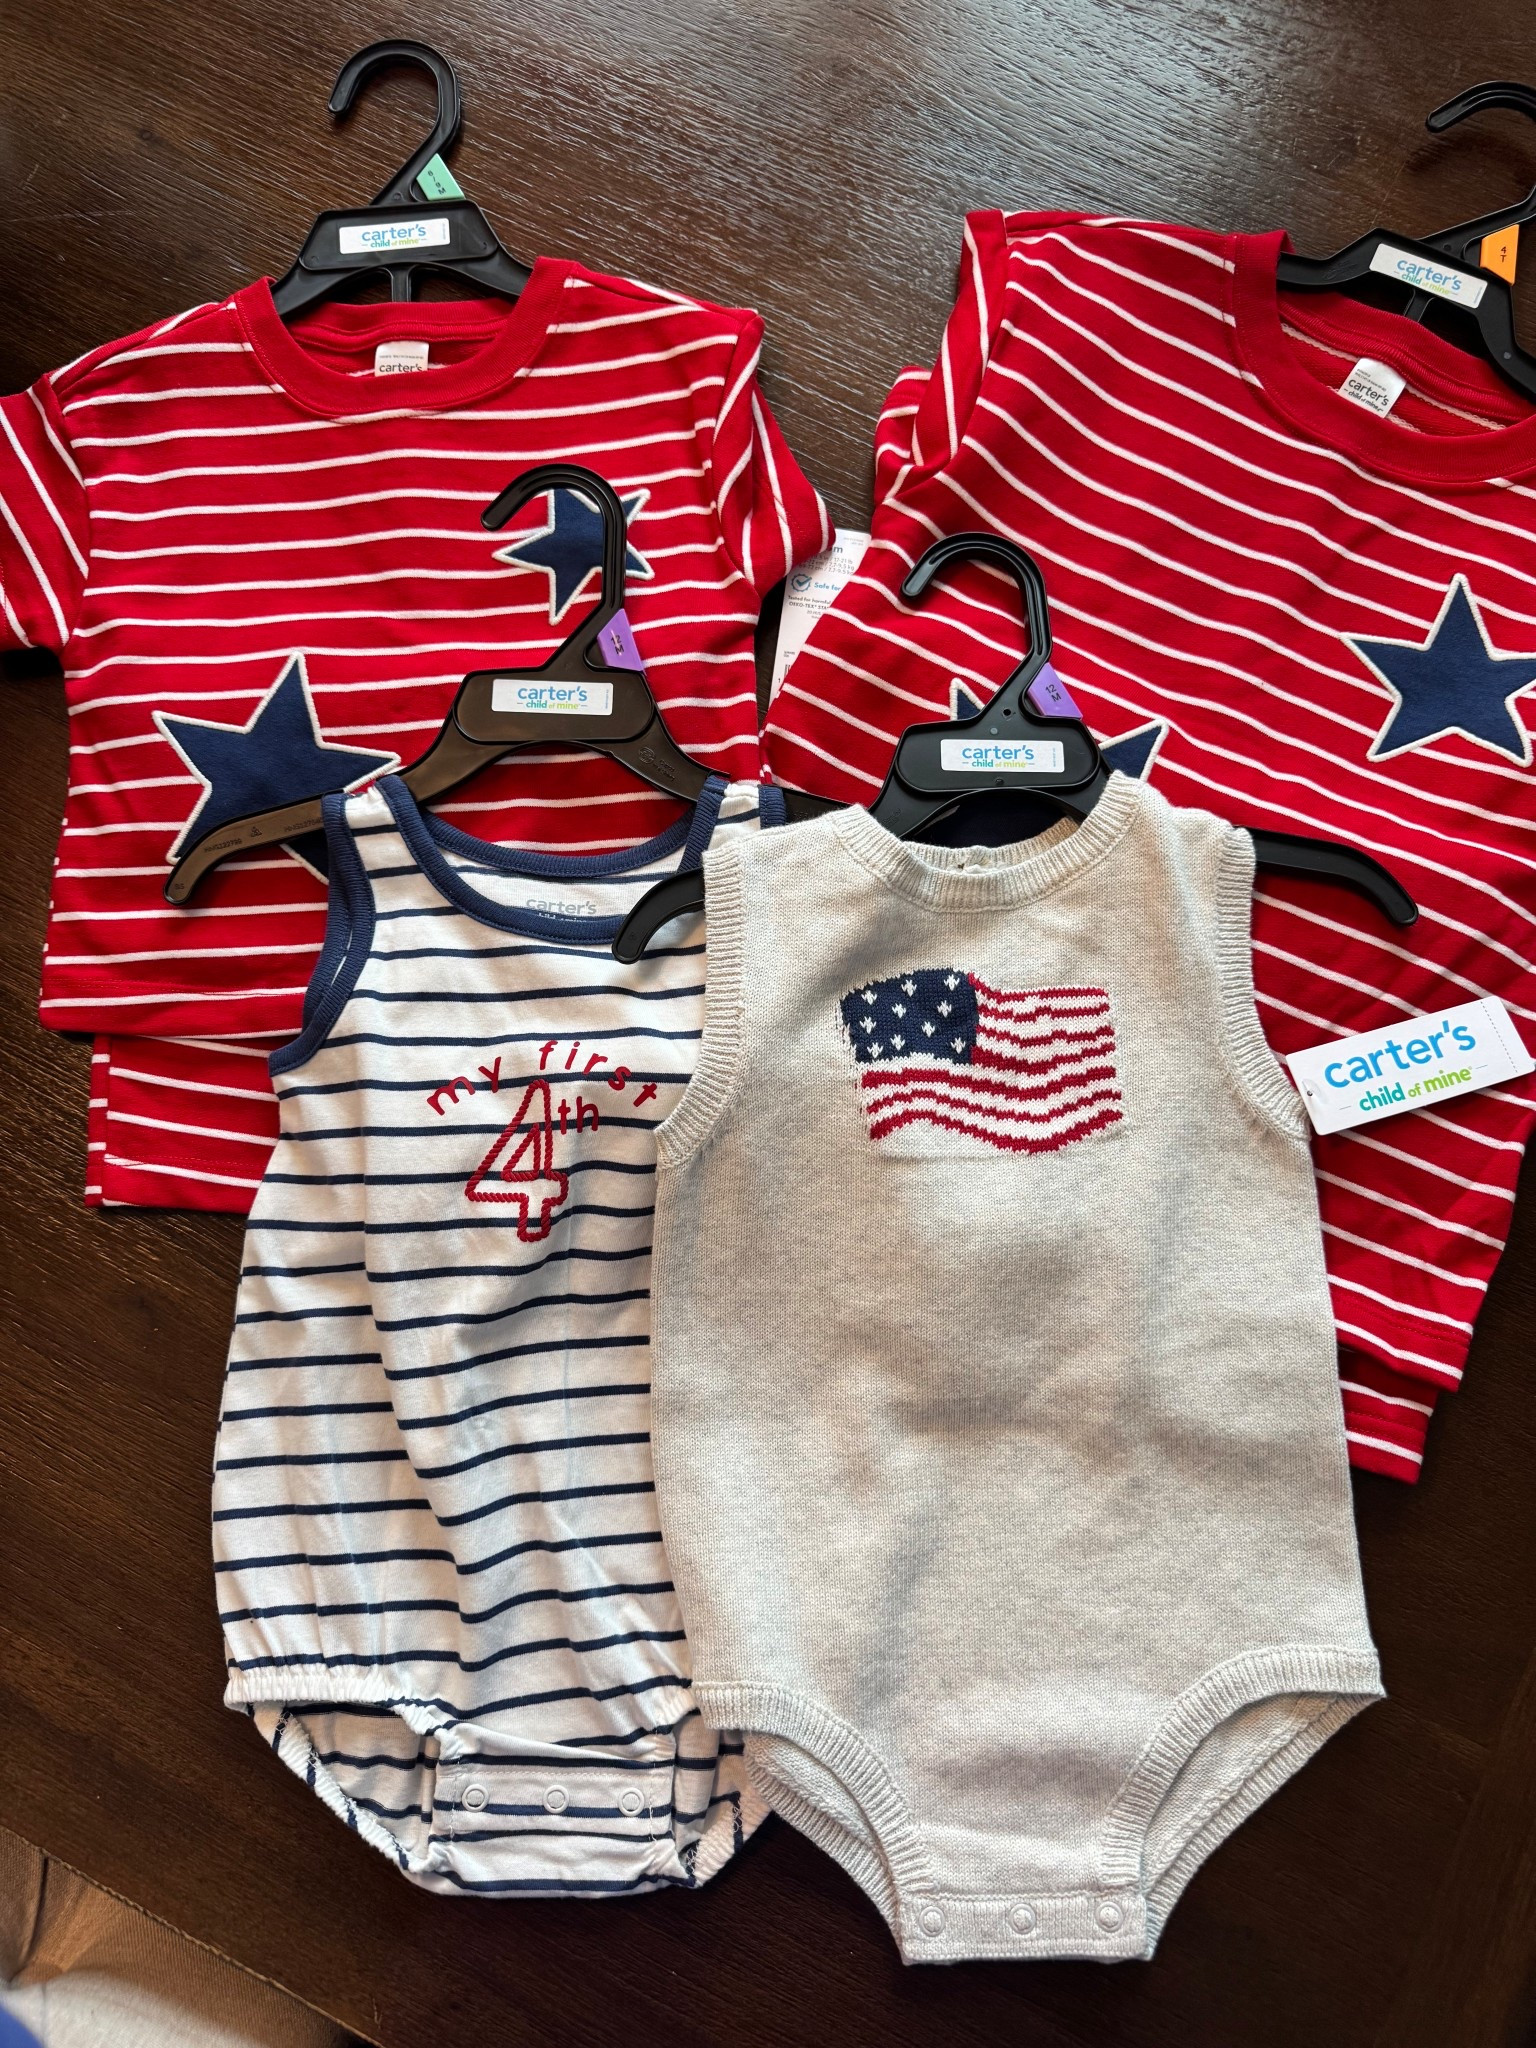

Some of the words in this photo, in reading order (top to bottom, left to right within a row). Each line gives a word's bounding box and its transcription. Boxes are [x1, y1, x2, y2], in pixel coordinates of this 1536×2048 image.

[361, 223, 427, 242] carter's
[370, 240, 391, 248] child
[398, 238, 420, 246] mine
[1396, 259, 1463, 292] carter's
[1401, 272, 1423, 285] child
[1429, 282, 1450, 295] mine
[379, 363, 423, 373] carter's
[1348, 379, 1389, 406] carter's
[814, 582, 830, 590] Safe
[517, 686, 588, 701] carter's
[525, 700, 548, 709] child
[556, 701, 579, 710] mine
[961, 744, 1035, 760] carter's
[971, 759, 994, 768] child
[1003, 760, 1027, 769] mine
[526, 899, 597, 915] carter's
[1324, 1019, 1477, 1089] carter's
[426, 1056, 502, 1116] my
[539, 1040, 658, 1108] first
[1359, 1081, 1406, 1112] child
[1407, 1083, 1422, 1099] of
[1423, 1065, 1473, 1094] mine
